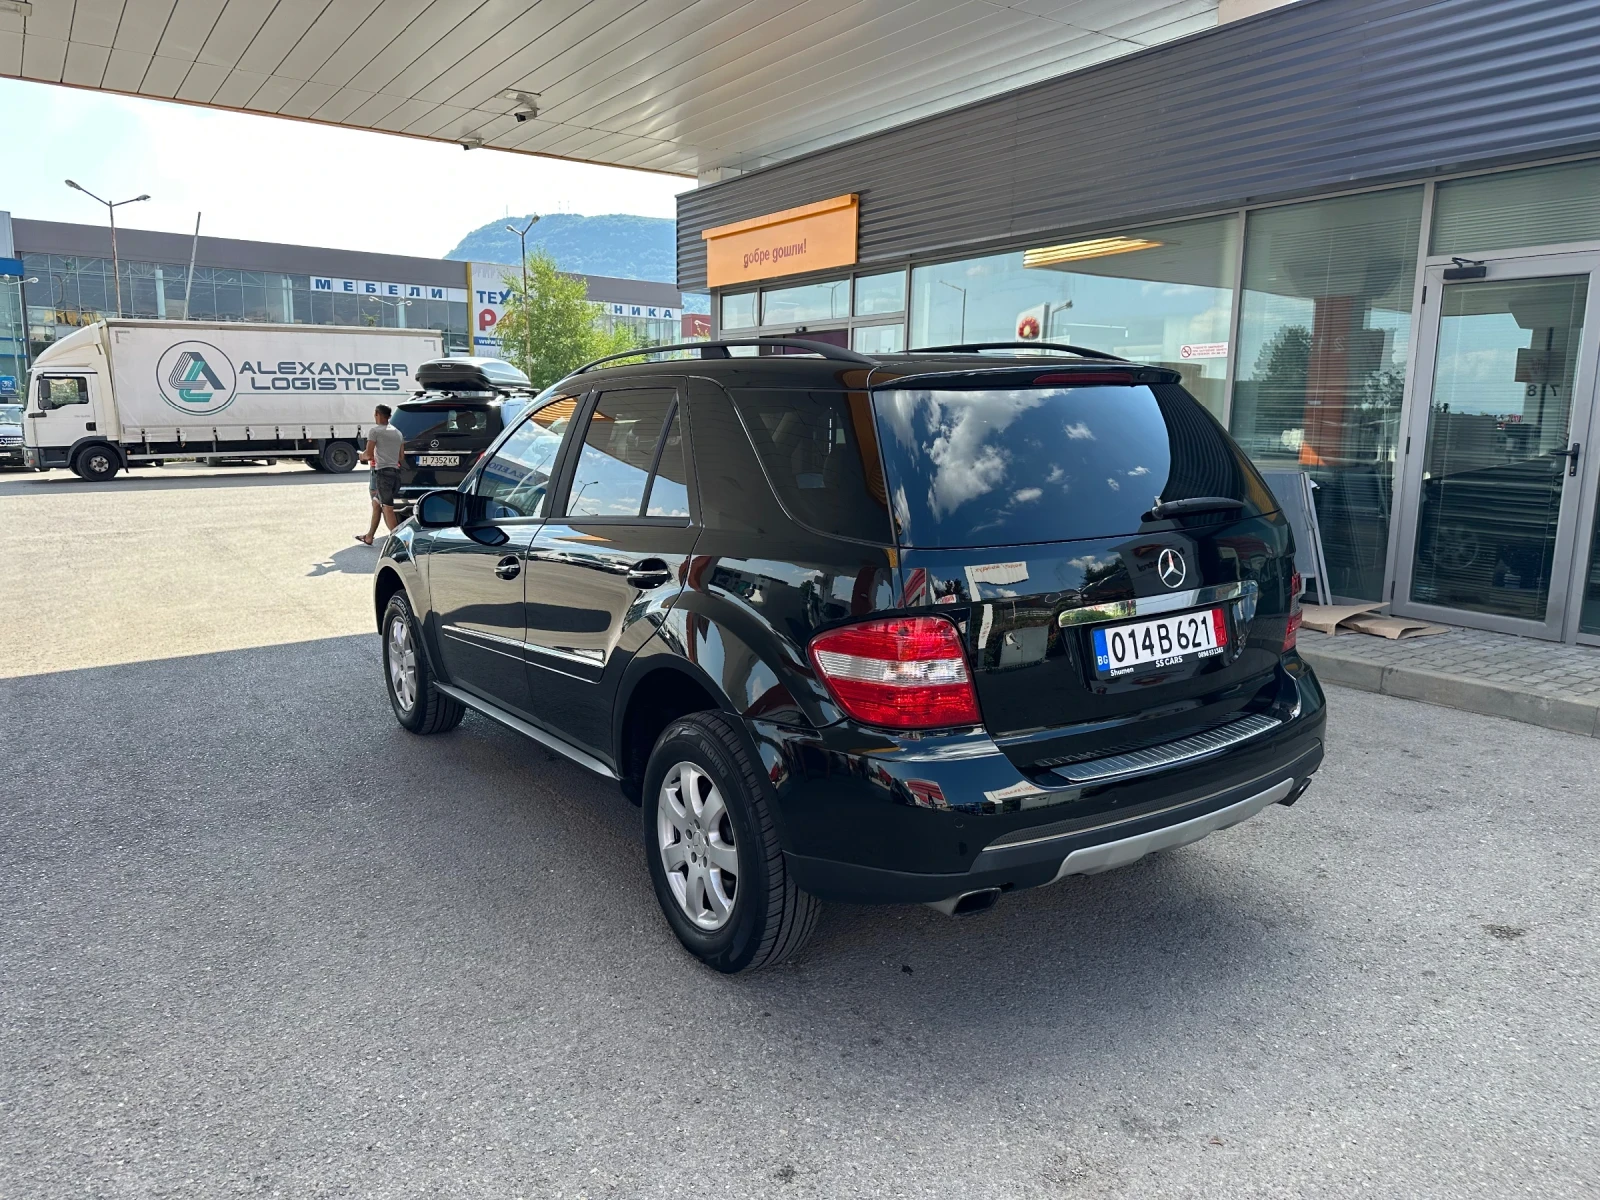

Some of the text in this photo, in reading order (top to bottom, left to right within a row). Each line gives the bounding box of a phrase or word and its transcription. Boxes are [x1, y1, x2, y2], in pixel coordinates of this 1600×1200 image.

[743, 237, 807, 269] добре дошли!
[315, 278, 448, 299] МЕБЕЛИ
[239, 360, 409, 377] ALEXANDER
[250, 376, 400, 391] LOGISTICS
[1097, 655, 1109, 665] BG
[1165, 655, 1183, 666] CARS
[1110, 667, 1134, 676] Shumen
